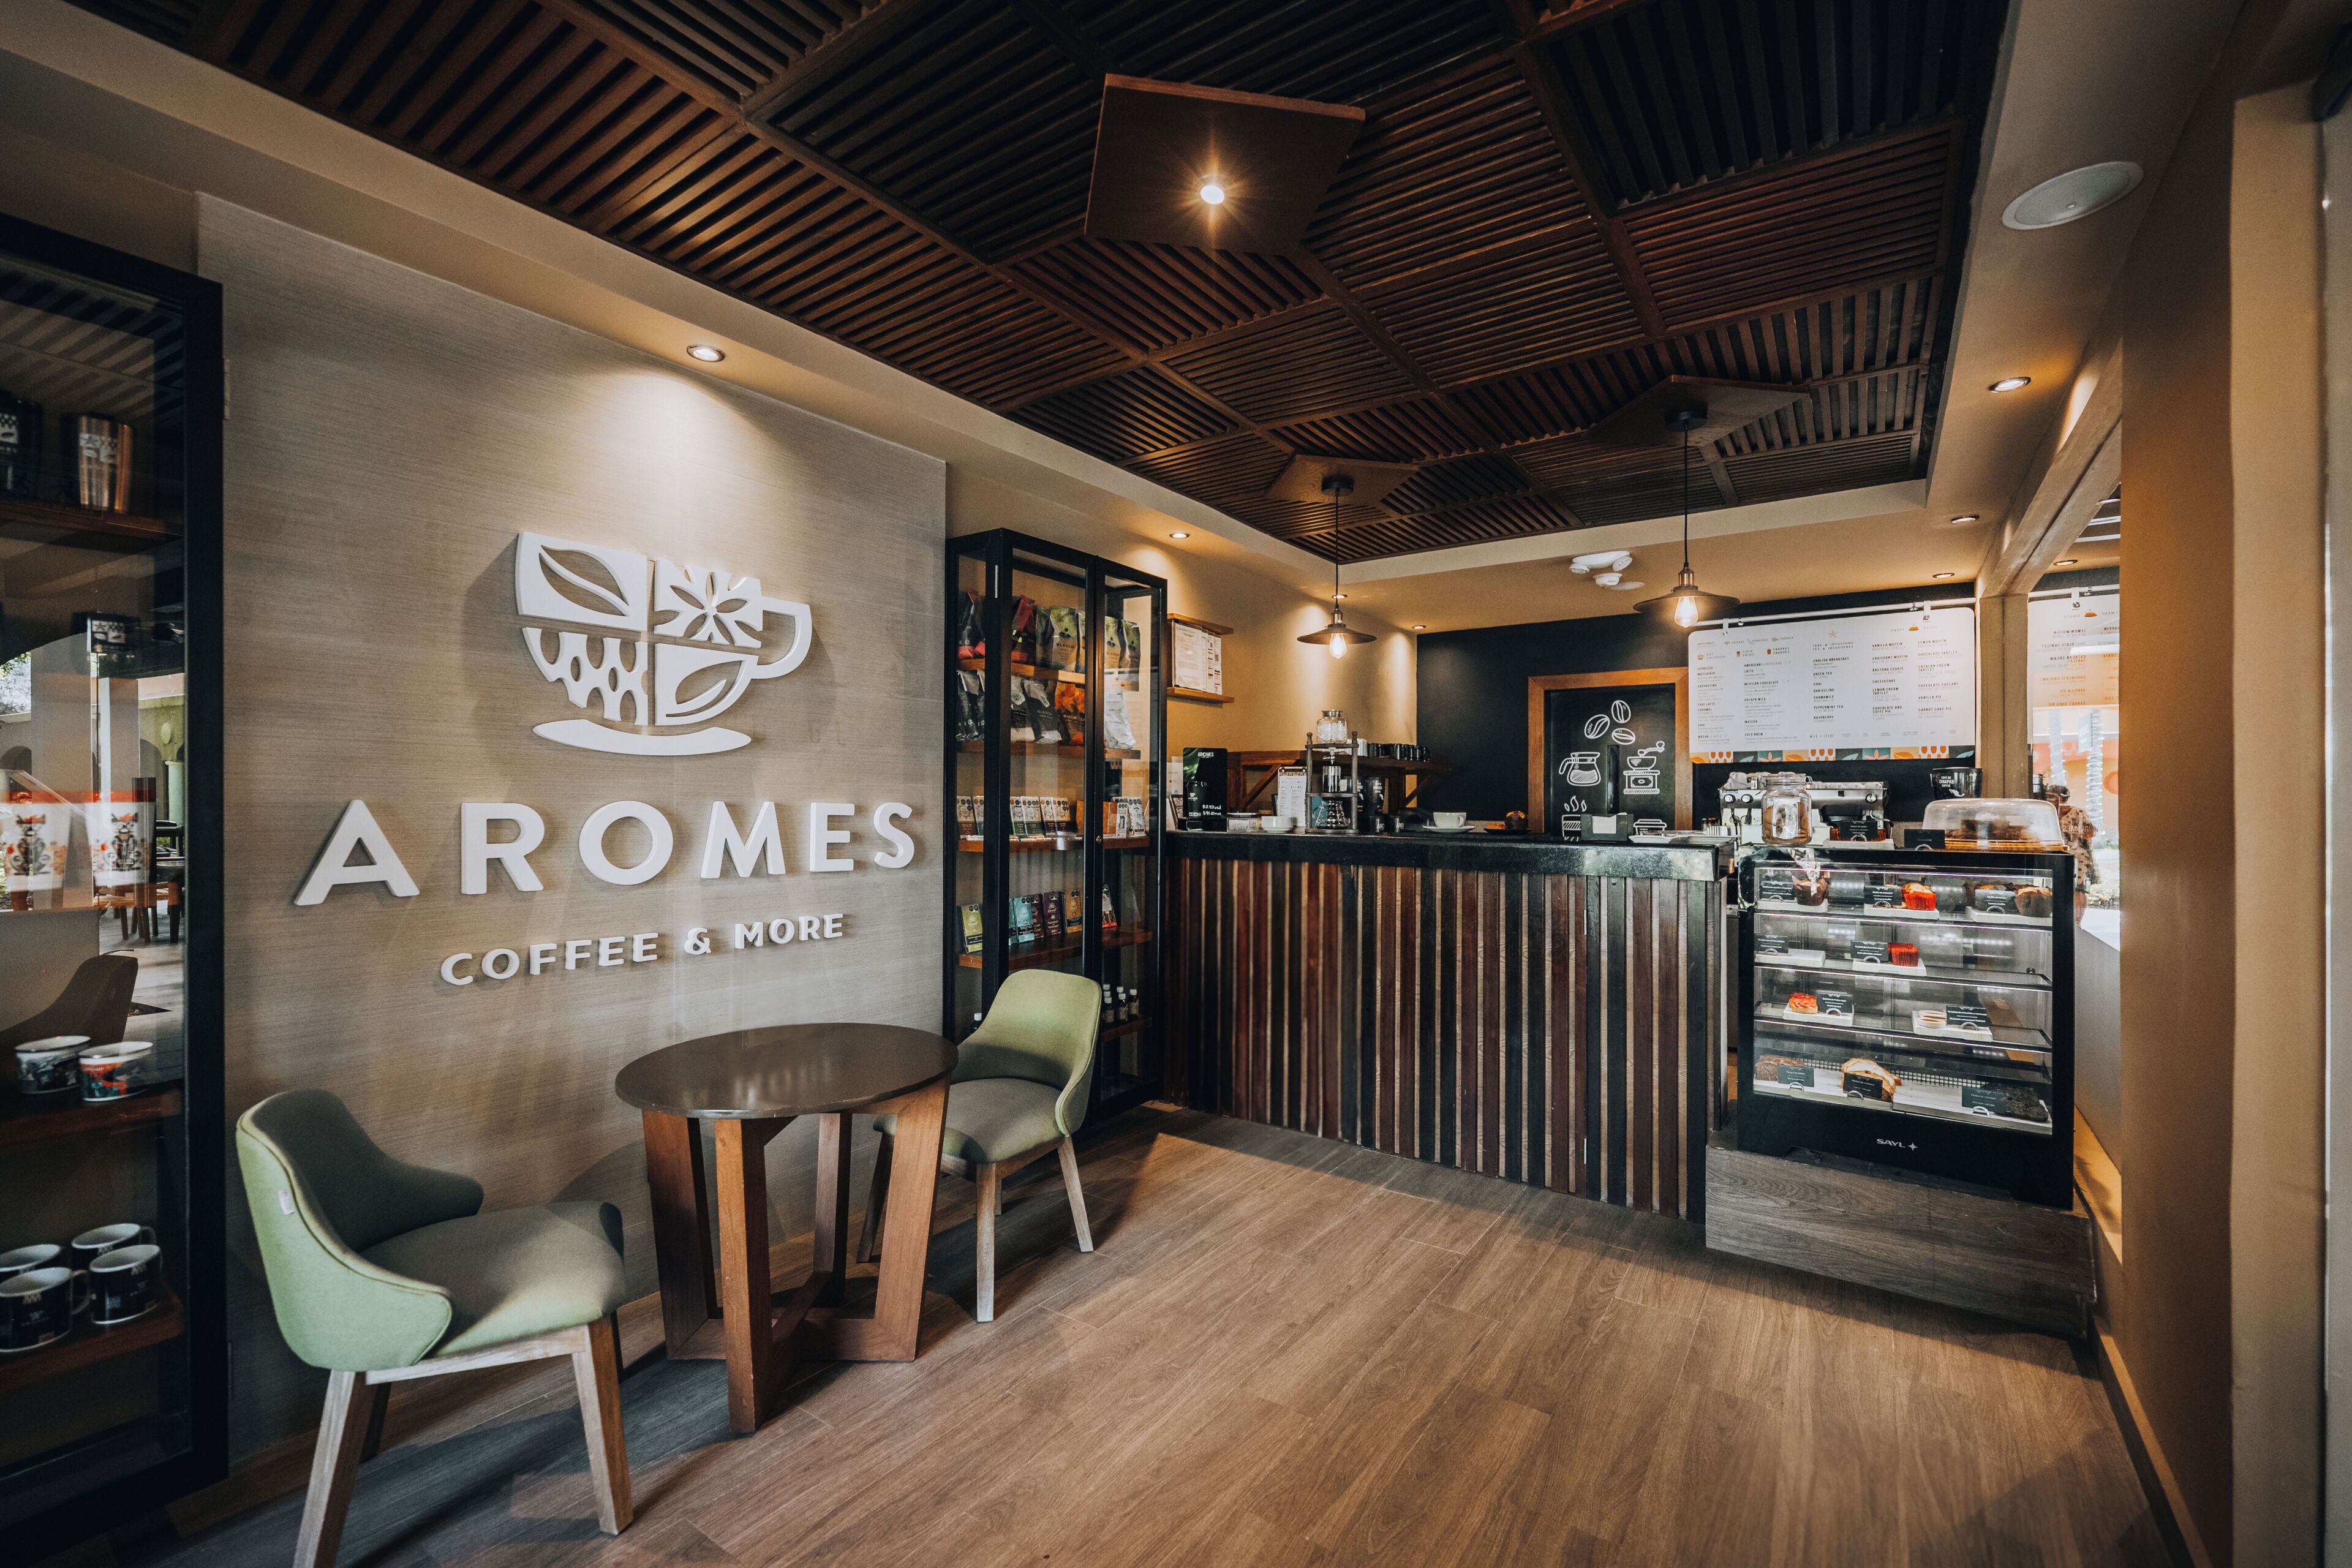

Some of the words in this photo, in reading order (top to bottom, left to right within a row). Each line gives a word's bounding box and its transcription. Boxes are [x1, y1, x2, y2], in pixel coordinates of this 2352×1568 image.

[294, 799, 916, 906] AROMES
[440, 931, 658, 986] COFFEE
[684, 926, 712, 956] &
[734, 912, 845, 950] MORE
[1877, 1138, 1906, 1148] SAYL
